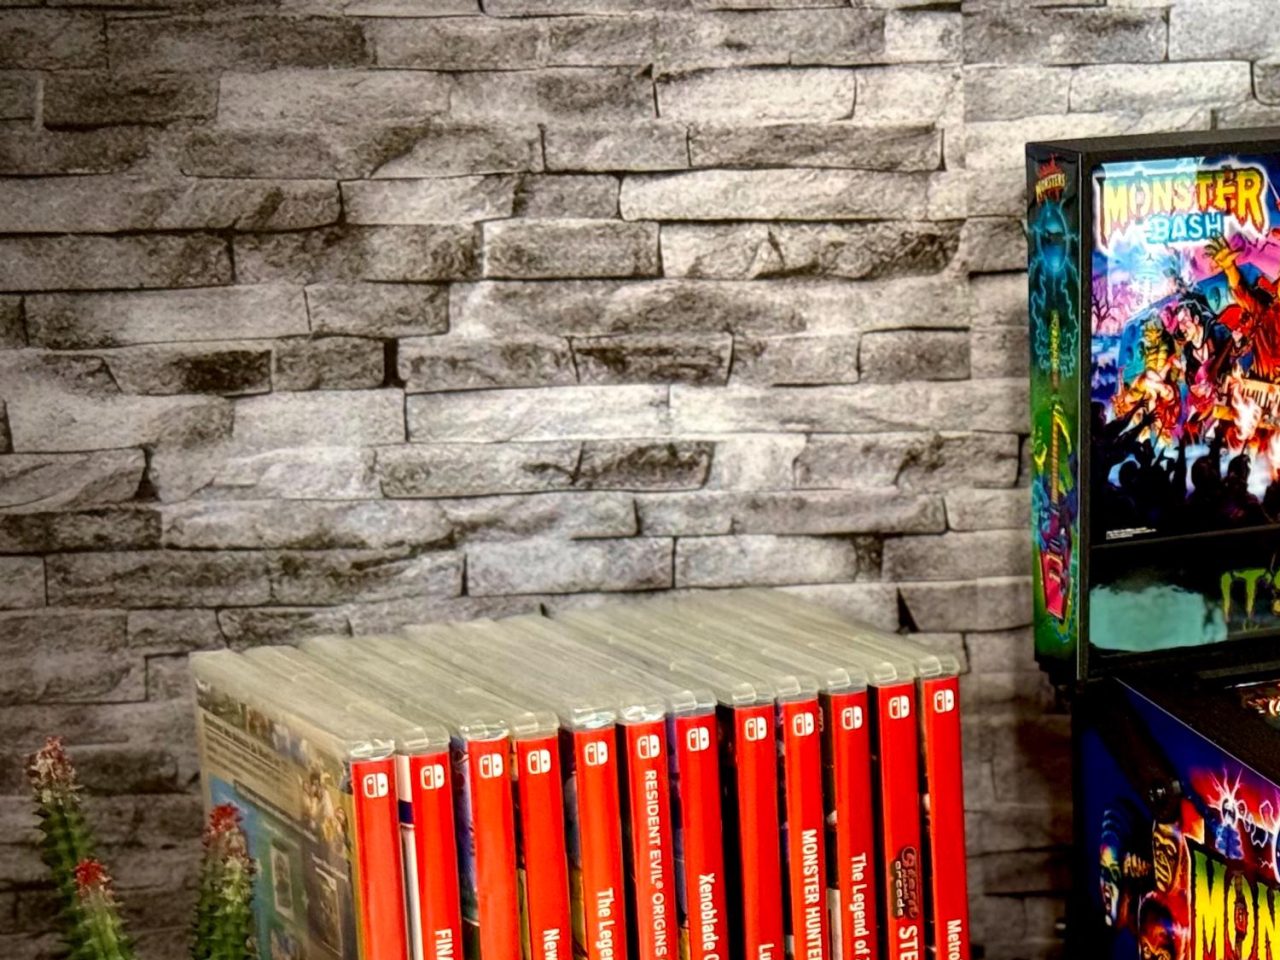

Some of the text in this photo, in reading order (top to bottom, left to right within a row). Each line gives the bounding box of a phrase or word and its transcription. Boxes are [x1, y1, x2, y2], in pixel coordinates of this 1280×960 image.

[1100, 167, 1265, 245] MONSTER
[1149, 213, 1224, 242] BASH
[644, 769, 661, 846] RESIDENT
[801, 829, 820, 905] MONSTER
[851, 852, 867, 882] The
[895, 860, 905, 917] arcade
[596, 887, 615, 918] The
[651, 892, 668, 957] ORIGINS
[698, 872, 719, 951] Xenoblade
[849, 883, 870, 937] Legend
[854, 939, 871, 955] of
